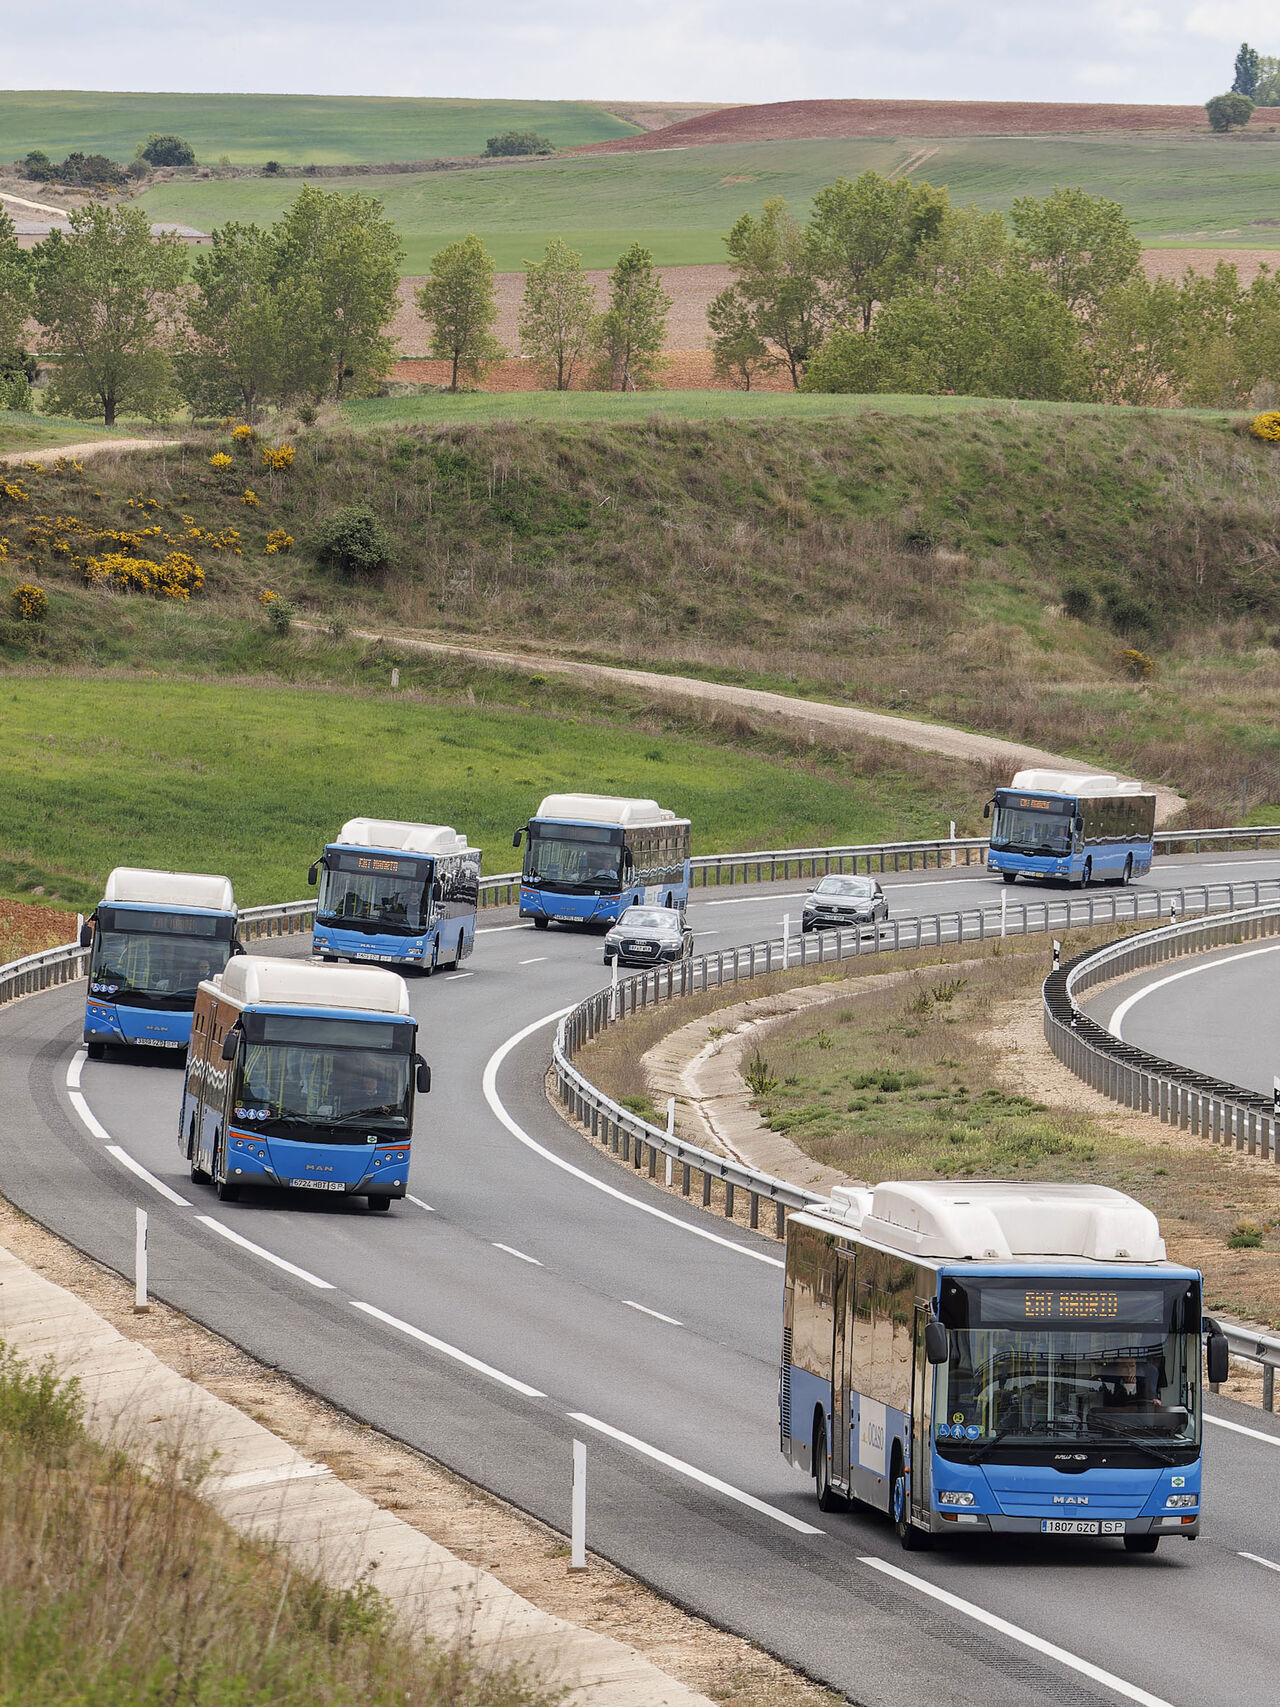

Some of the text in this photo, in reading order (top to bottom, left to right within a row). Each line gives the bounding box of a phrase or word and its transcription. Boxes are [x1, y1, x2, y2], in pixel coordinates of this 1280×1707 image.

[305, 1164, 334, 1172] MAN
[294, 1179, 311, 1187] 6724
[1025, 1292, 1118, 1317] EMT MADRID
[1053, 1496, 1089, 1505] MAN
[1049, 1522, 1073, 1532] 1807
[1076, 1523, 1096, 1533] GZC
